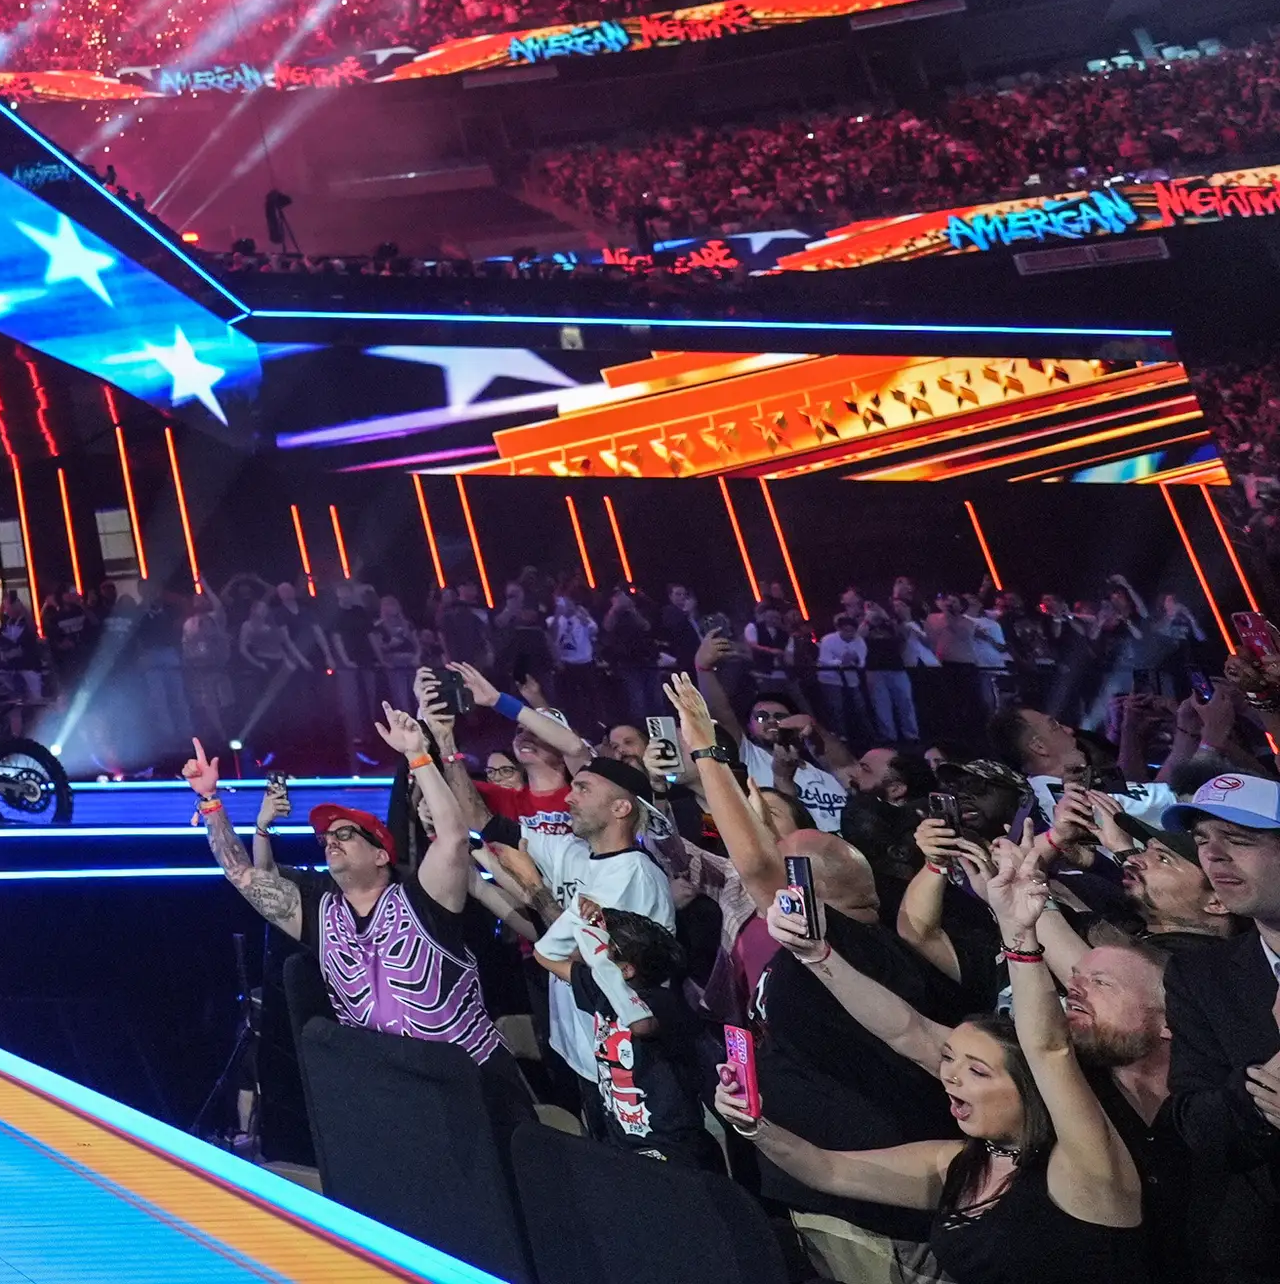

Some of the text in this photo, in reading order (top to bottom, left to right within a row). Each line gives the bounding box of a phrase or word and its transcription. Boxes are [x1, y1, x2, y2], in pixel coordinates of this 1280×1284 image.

[509, 19, 630, 63] AMERICAN
[159, 63, 262, 93] AMERICAN
[942, 188, 1138, 251] AMERICAN
[795, 786, 847, 817] odger
